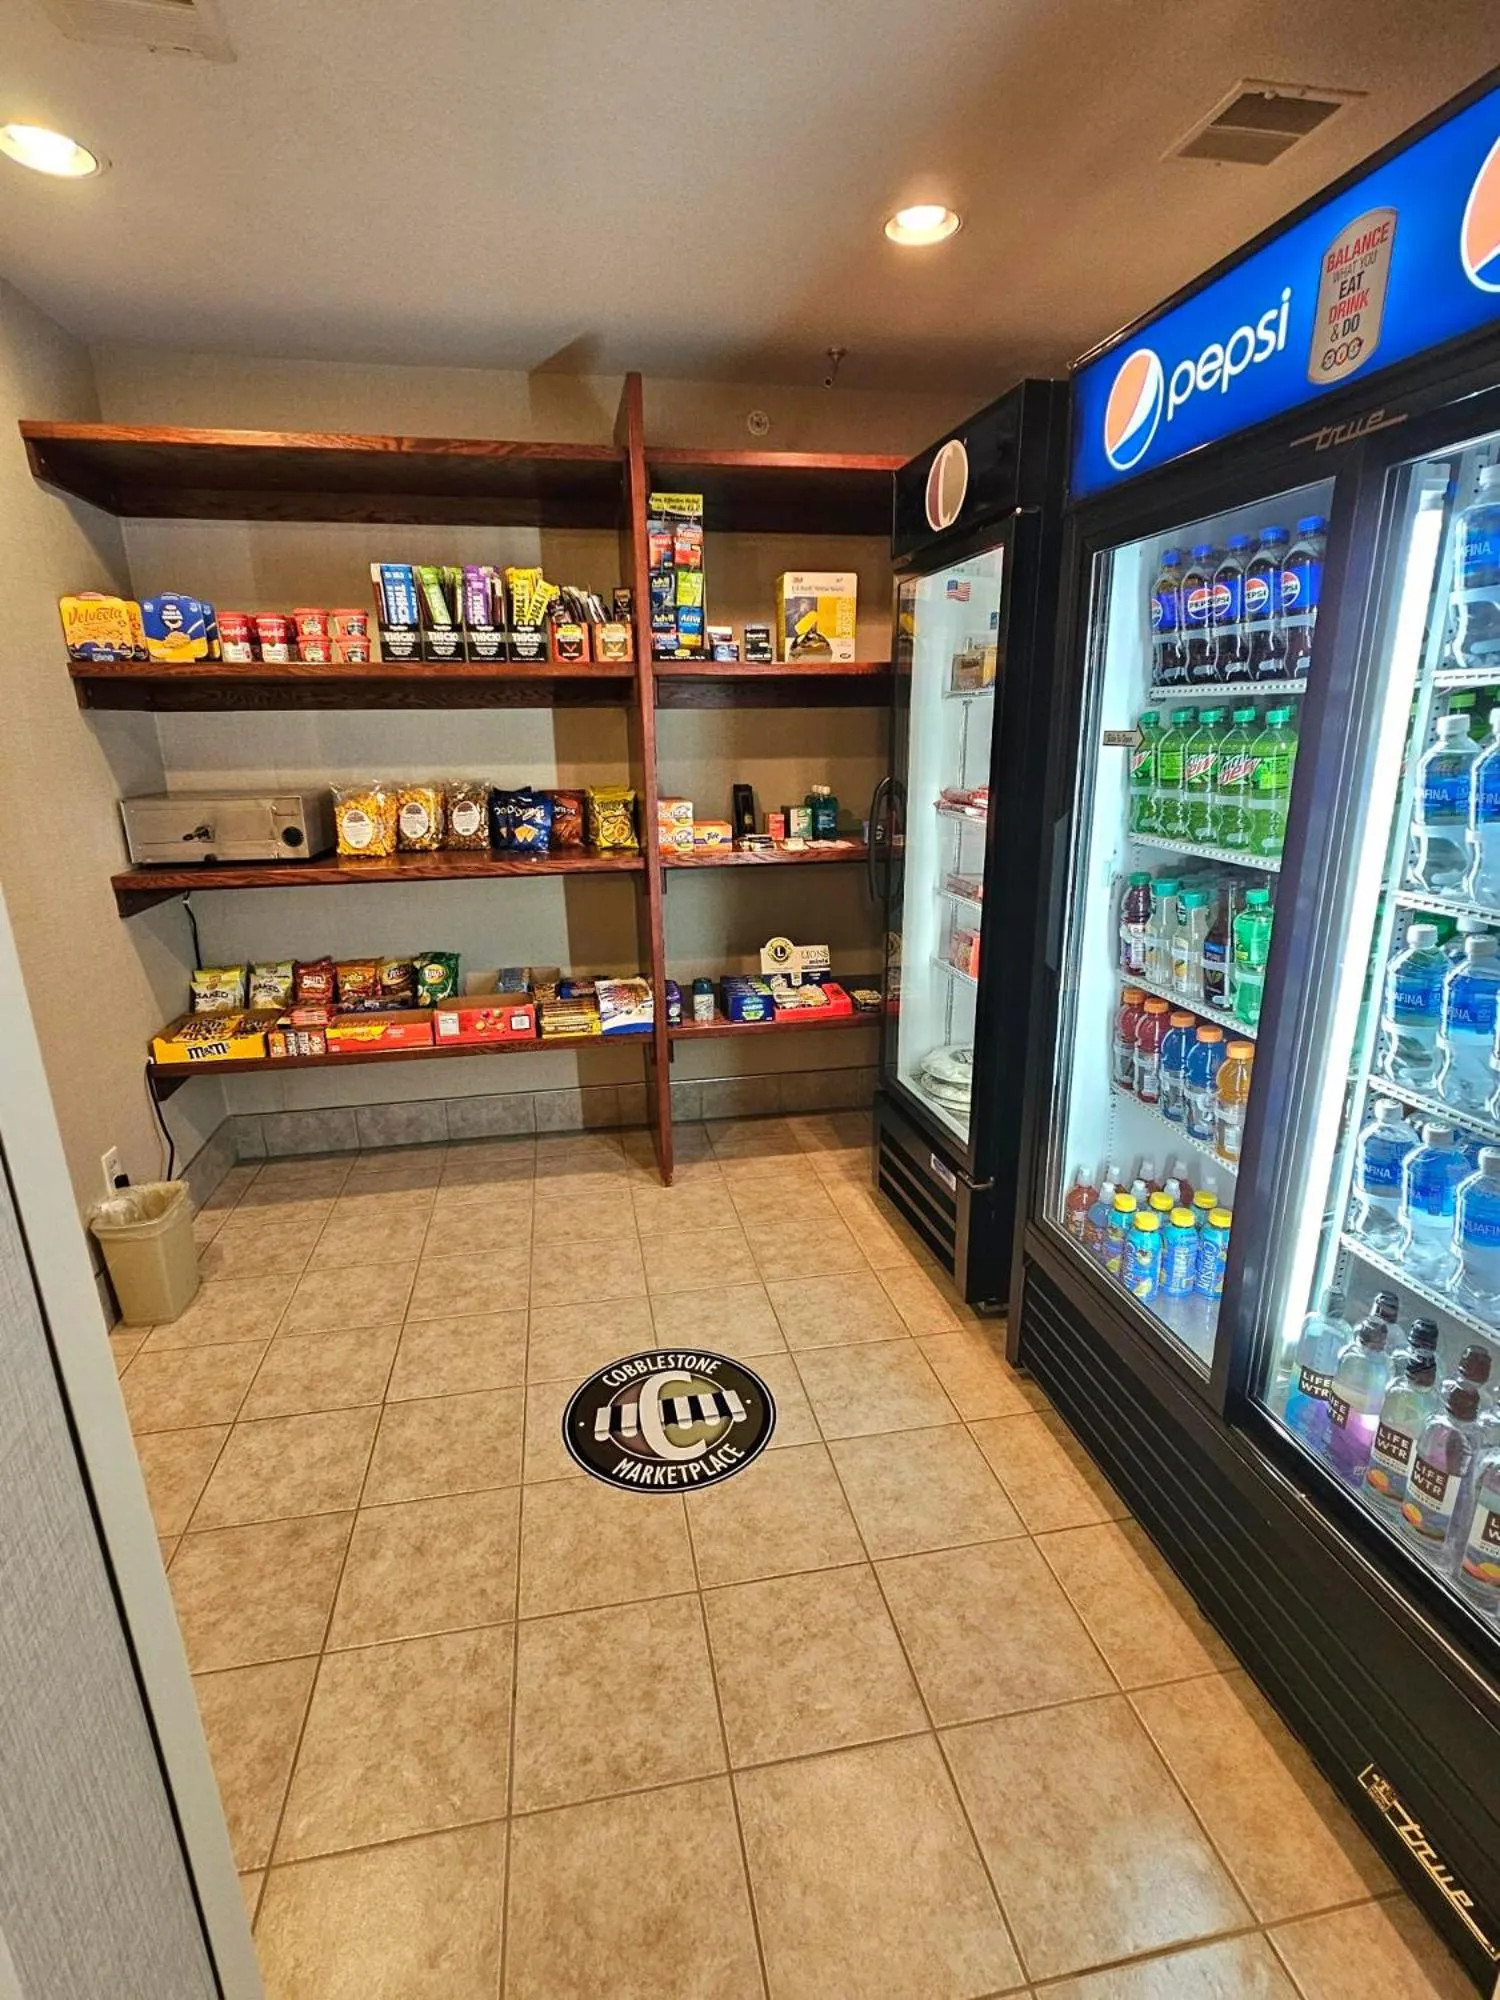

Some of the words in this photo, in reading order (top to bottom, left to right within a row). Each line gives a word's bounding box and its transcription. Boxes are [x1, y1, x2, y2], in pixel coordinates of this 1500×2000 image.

[1326, 222, 1390, 273] BALANCE
[1332, 260, 1358, 283] WHAT
[1359, 249, 1379, 270] YOU
[1338, 270, 1366, 300] EAT
[1327, 288, 1371, 325] DRINK
[1329, 323, 1340, 343] &
[1341, 313, 1361, 337] DO
[1167, 287, 1291, 422] pepsi
[68, 606, 123, 626] Velveeta
[601, 1354, 722, 1387] COBBLESTONE
[1302, 1371, 1332, 1388] LIFE
[1301, 1381, 1329, 1397] WTR
[1377, 1437, 1408, 1459] WTR
[1379, 1427, 1410, 1449] LIFE
[611, 1442, 746, 1485] MARKETPLACE
[1415, 1460, 1445, 1485] LIFE
[1414, 1471, 1442, 1496] WTR
